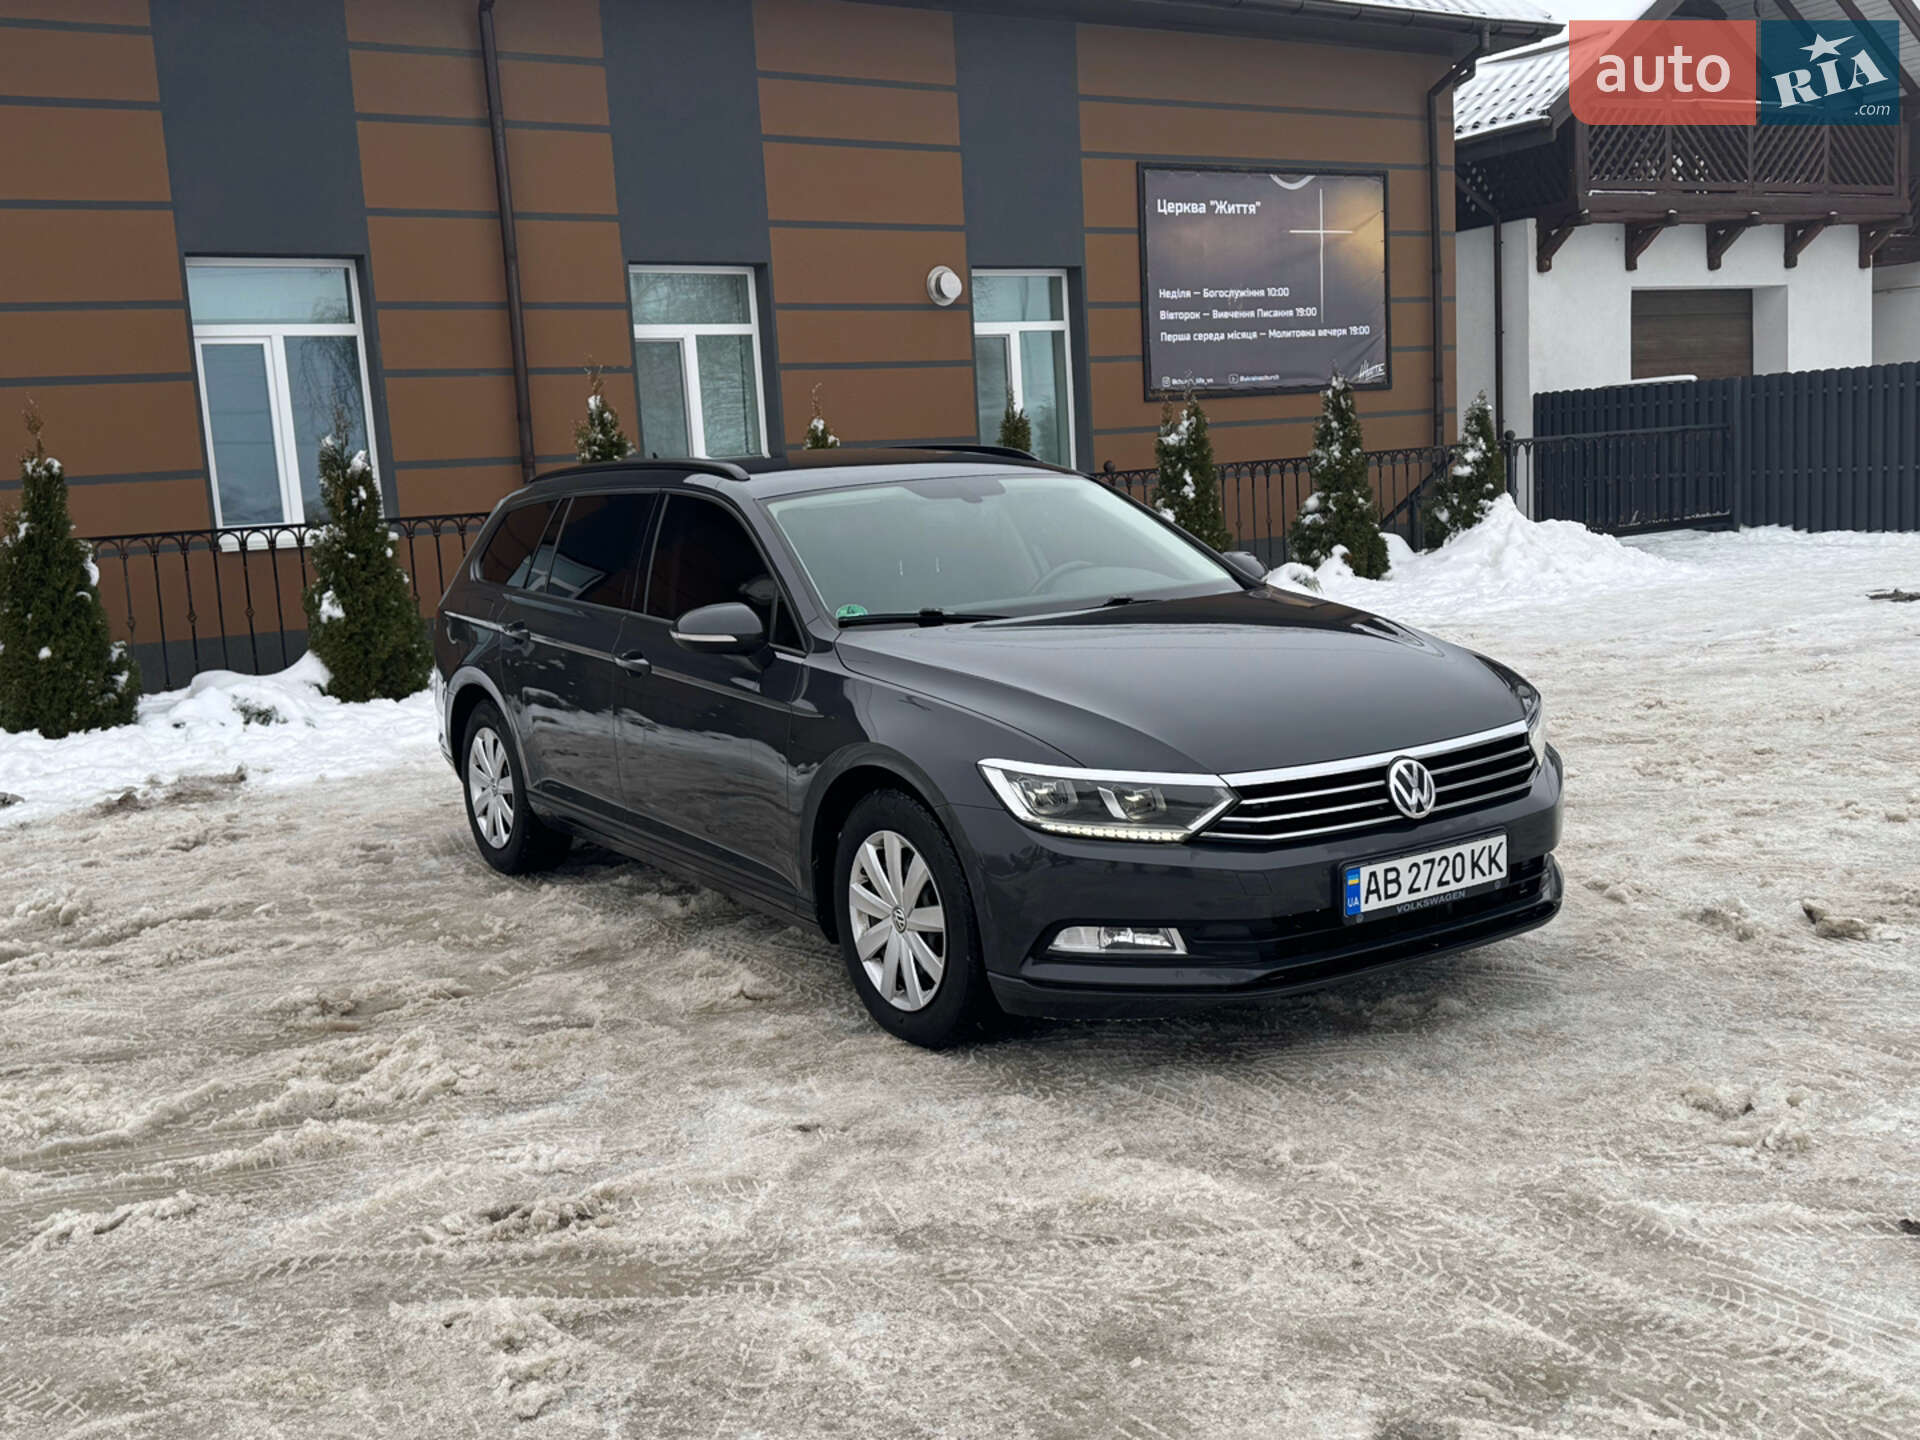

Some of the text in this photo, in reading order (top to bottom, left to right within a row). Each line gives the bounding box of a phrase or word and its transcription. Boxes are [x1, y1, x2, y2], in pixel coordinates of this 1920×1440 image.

[1157, 199, 1261, 216] Церква "Життя"
[1159, 288, 1191, 299] Неділя
[1203, 287, 1265, 300] Богослужіння
[1267, 287, 1290, 297] 10:00
[1160, 310, 1201, 321] Вівторок
[1212, 309, 1255, 319] Вивчення
[1257, 308, 1294, 318] Писання
[1295, 307, 1318, 317] 19:00
[1160, 332, 1191, 343] Перша
[1193, 332, 1225, 342] середа
[1227, 331, 1258, 340] місяця
[1268, 329, 1316, 339] Молитовна
[1349, 325, 1371, 336] 19:00
[1364, 841, 1504, 905] AB 2720 KK
[1347, 897, 1360, 908] UA
[1396, 890, 1466, 914] VOLKSWAGEN
